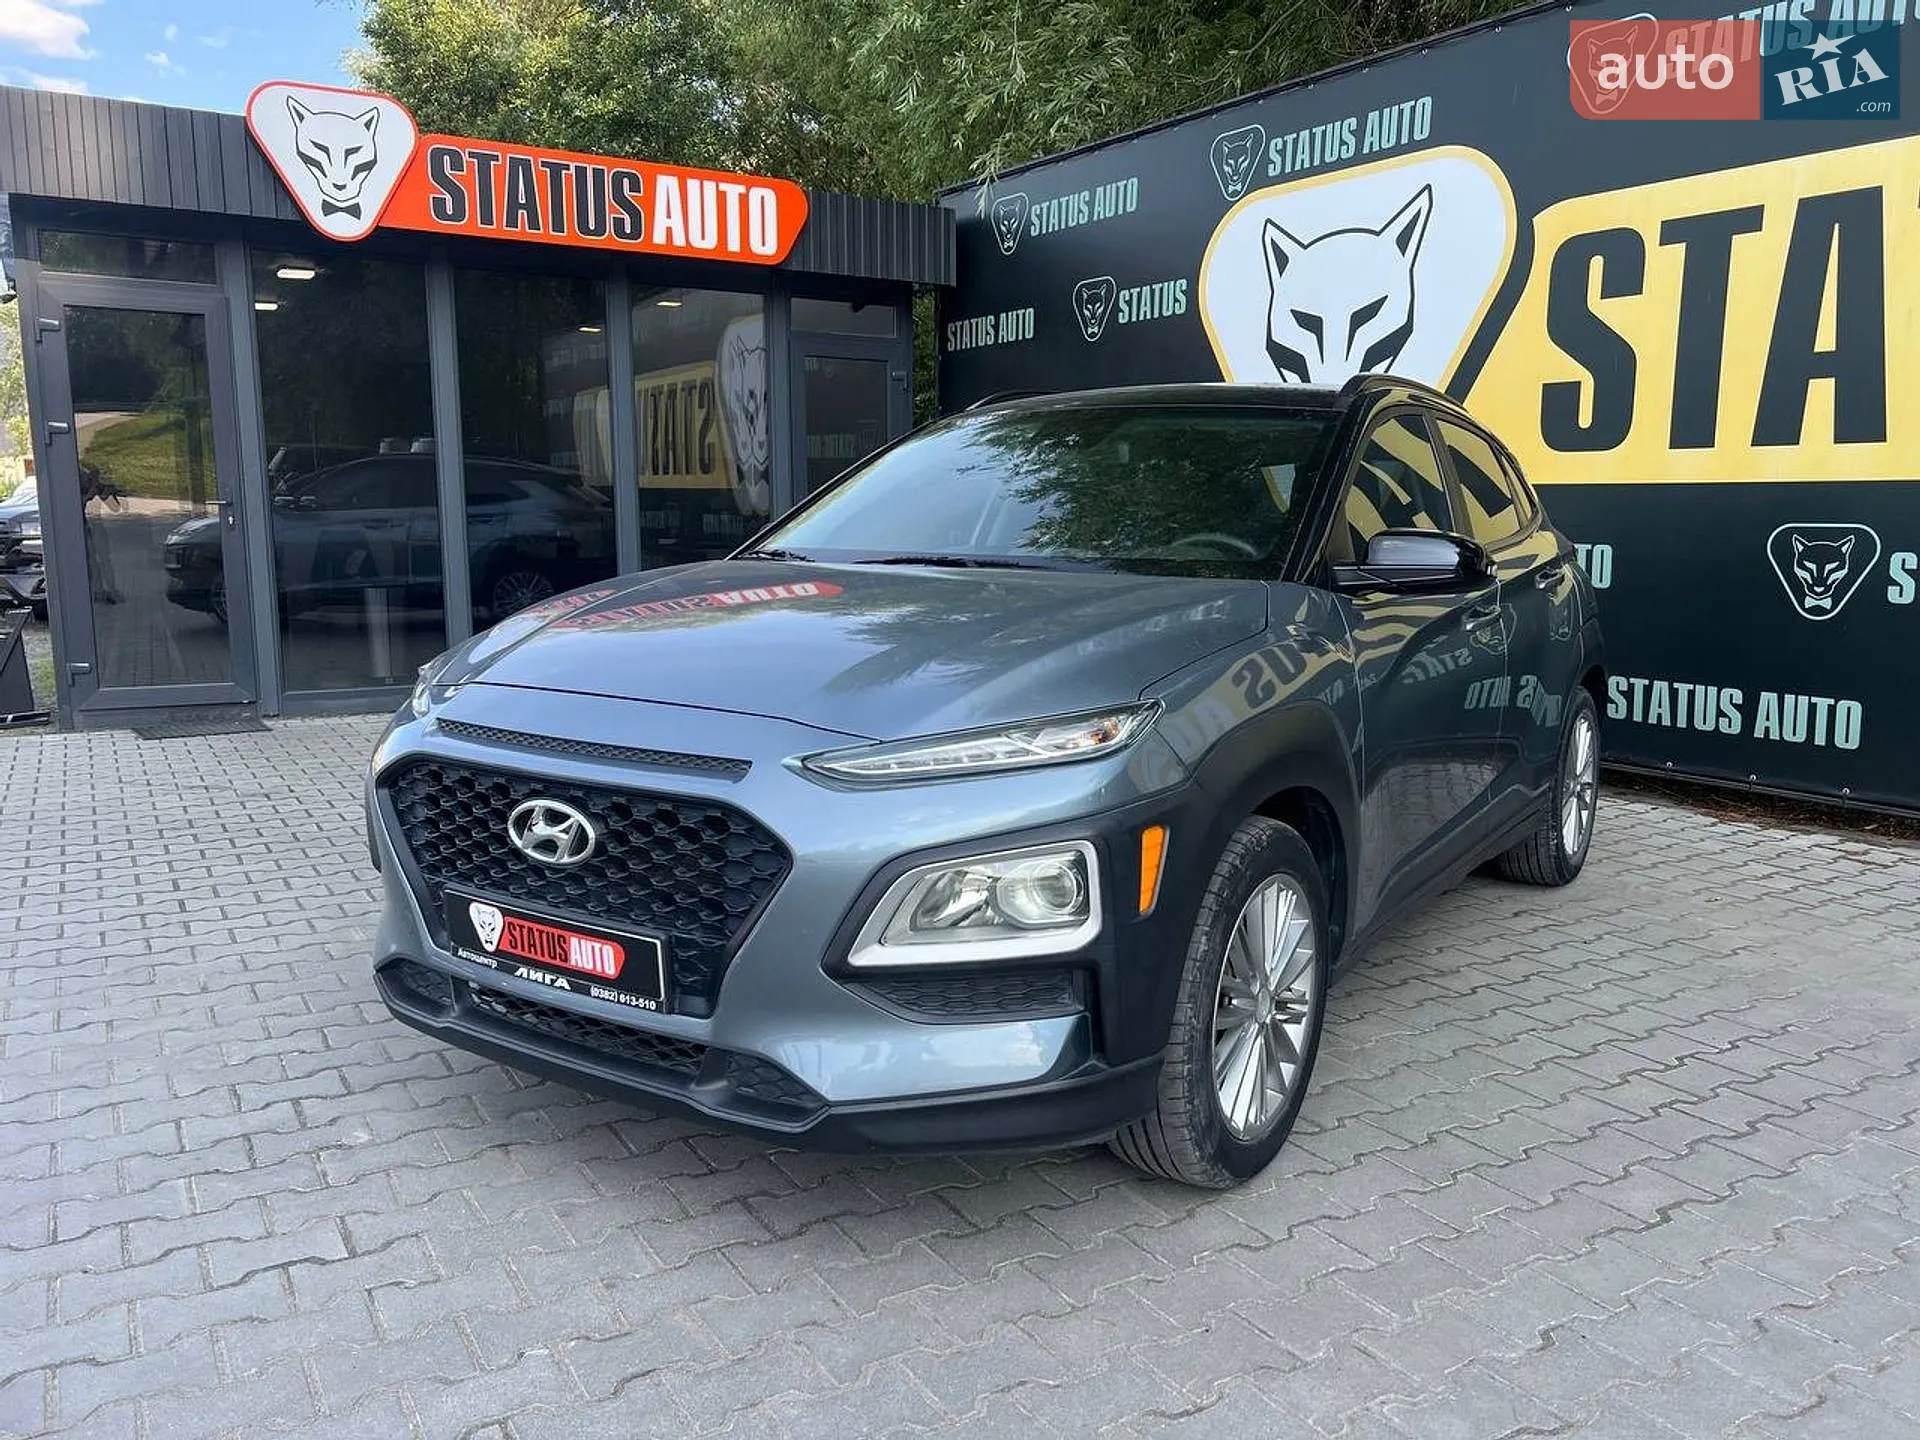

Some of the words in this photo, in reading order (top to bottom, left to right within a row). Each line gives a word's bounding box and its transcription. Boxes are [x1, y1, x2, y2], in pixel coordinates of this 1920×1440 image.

[1267, 117, 1357, 177] STATUS
[1362, 96, 1432, 154] AUTO
[427, 144, 644, 243] STATUS
[653, 174, 778, 256] AUTO
[1030, 190, 1089, 237] STATUS
[1093, 177, 1138, 221] AUTO
[947, 316, 994, 352] STATUS
[999, 307, 1034, 343] AUTO
[1118, 279, 1187, 324] STATUS
[1541, 185, 1920, 452] STA
[1887, 552, 1918, 604] S
[1606, 675, 1743, 734] STATUS
[1753, 691, 1862, 750] AUTO
[507, 921, 568, 963] STATUS
[569, 935, 616, 976] AUTO
[514, 967, 572, 991] ЛИГА
[619, 993, 656, 1010] 613-510
